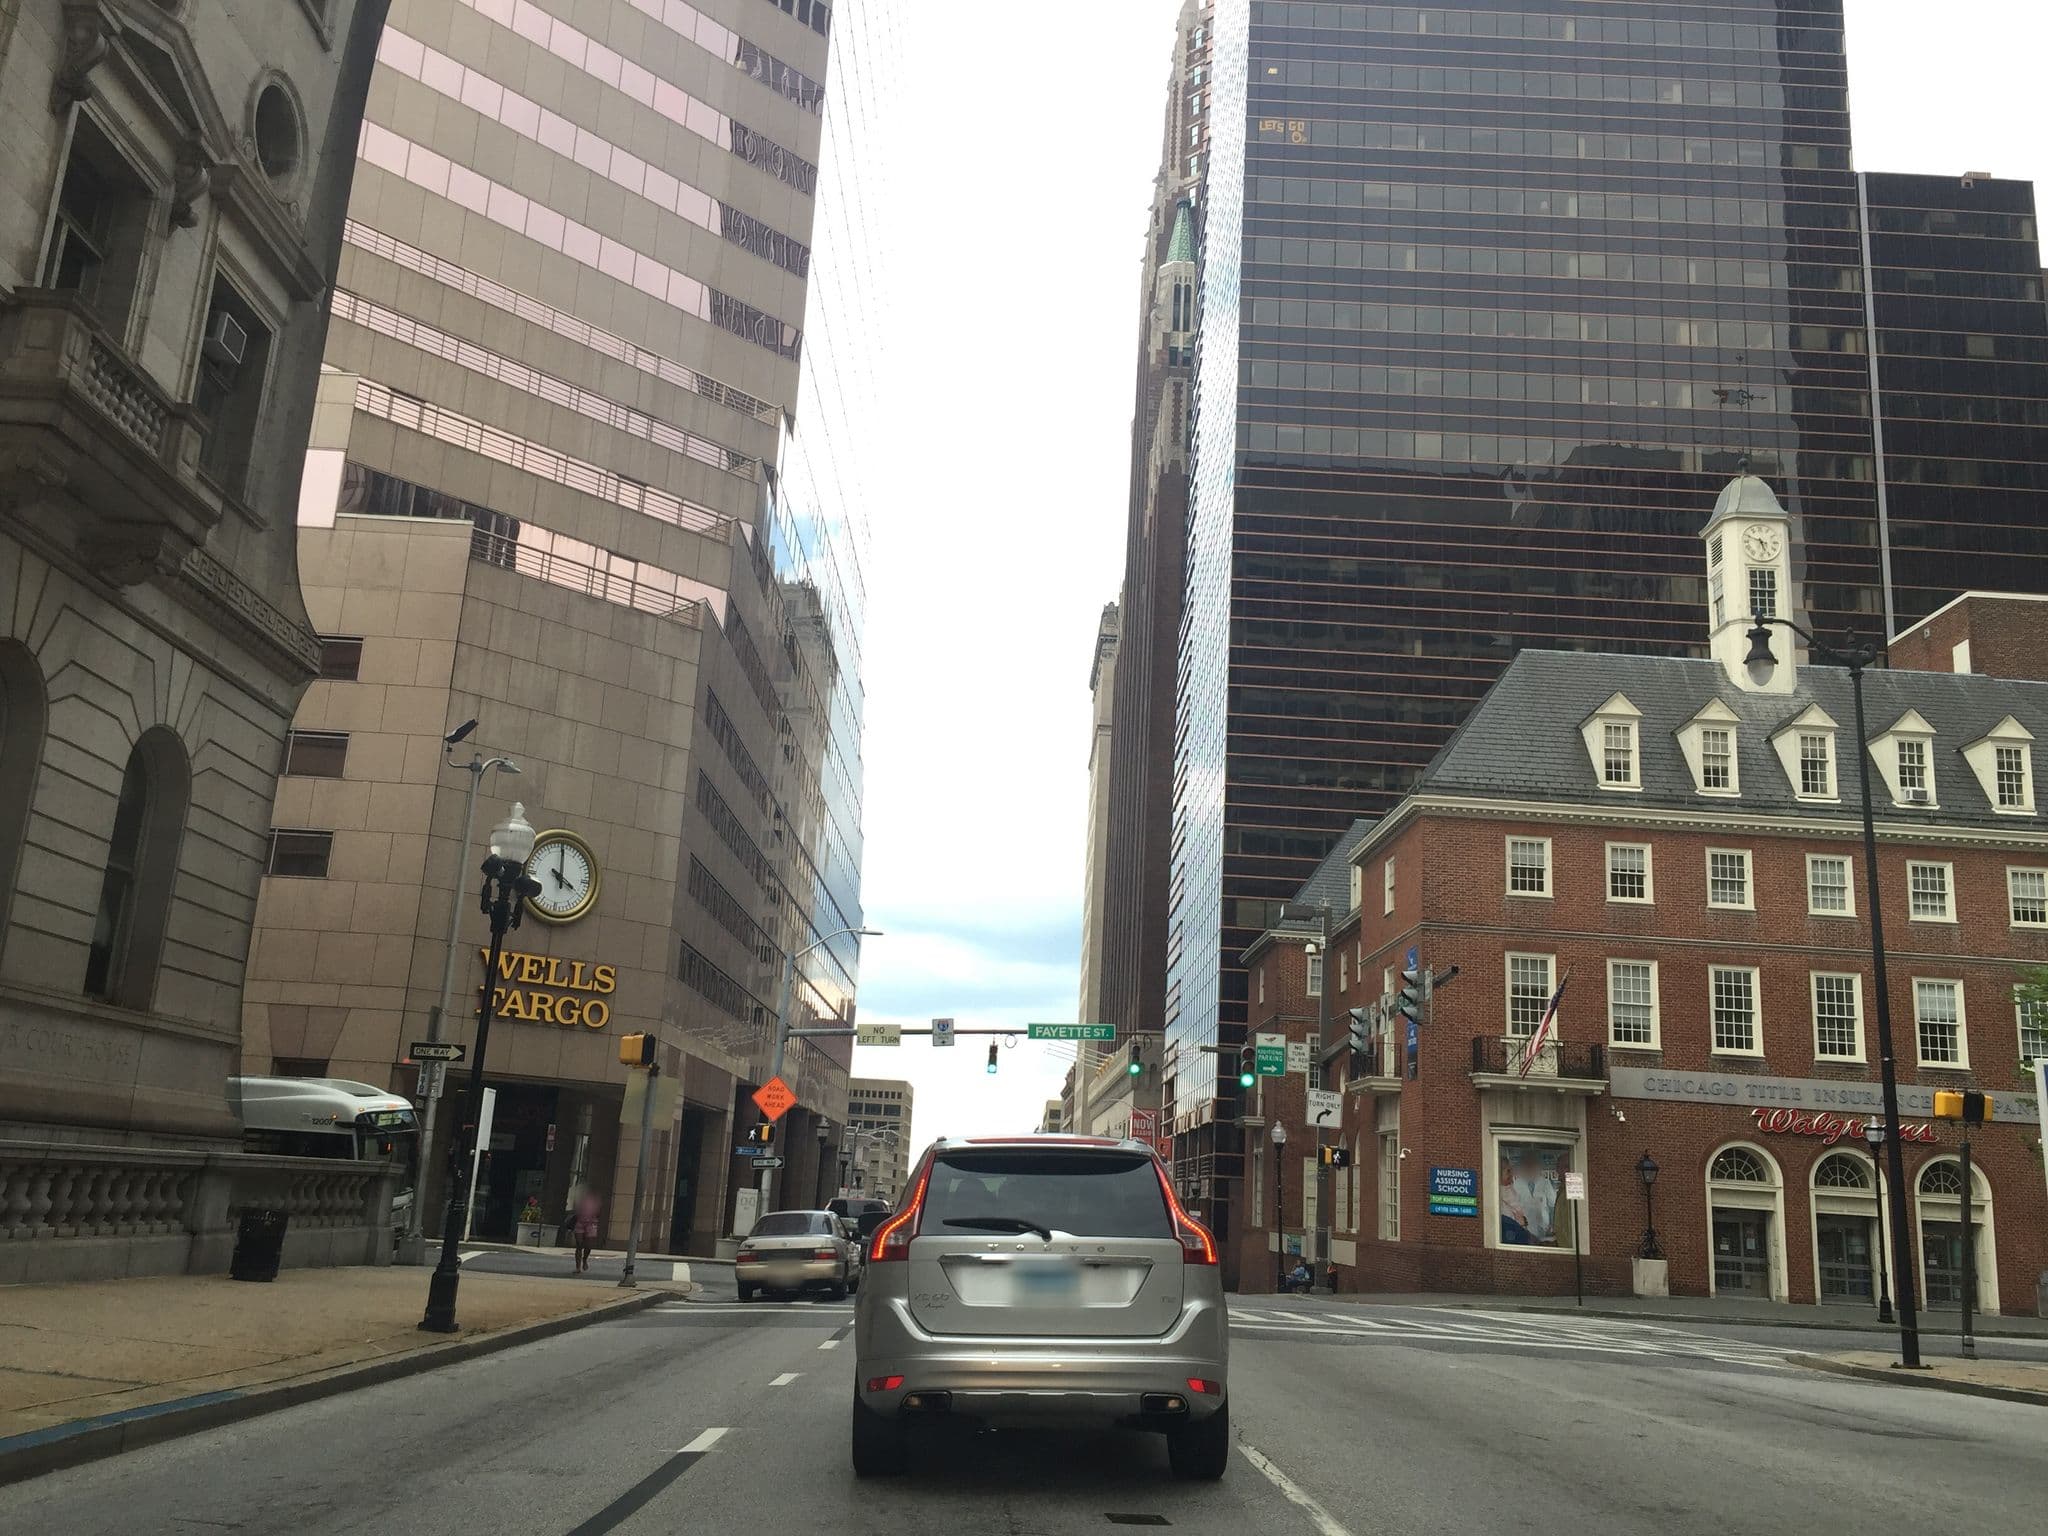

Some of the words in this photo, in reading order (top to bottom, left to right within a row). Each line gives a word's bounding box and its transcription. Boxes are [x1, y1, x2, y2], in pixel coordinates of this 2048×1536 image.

[481, 948, 616, 994] WELLS
[475, 985, 610, 1029] FARGO
[873, 1026, 886, 1034] NO
[1035, 1026, 1092, 1038] FAYETTE
[1093, 1029, 1110, 1038] ST.
[857, 1034, 875, 1043] LEFT
[881, 1035, 900, 1044] TURN
[416, 1047, 431, 1056] ONE
[1643, 1077, 1738, 1097] CHICAGO
[1745, 1084, 1801, 1101] TITLE
[1315, 1093, 1335, 1101] RIGHT
[1133, 1118, 1153, 1129] NOW
[1437, 1169, 1470, 1178] NURSING
[1435, 1177, 1472, 1186] ASSISTANT
[1438, 1185, 1469, 1194] SCHOOL
[987, 1243, 1105, 1253] VOLVO
